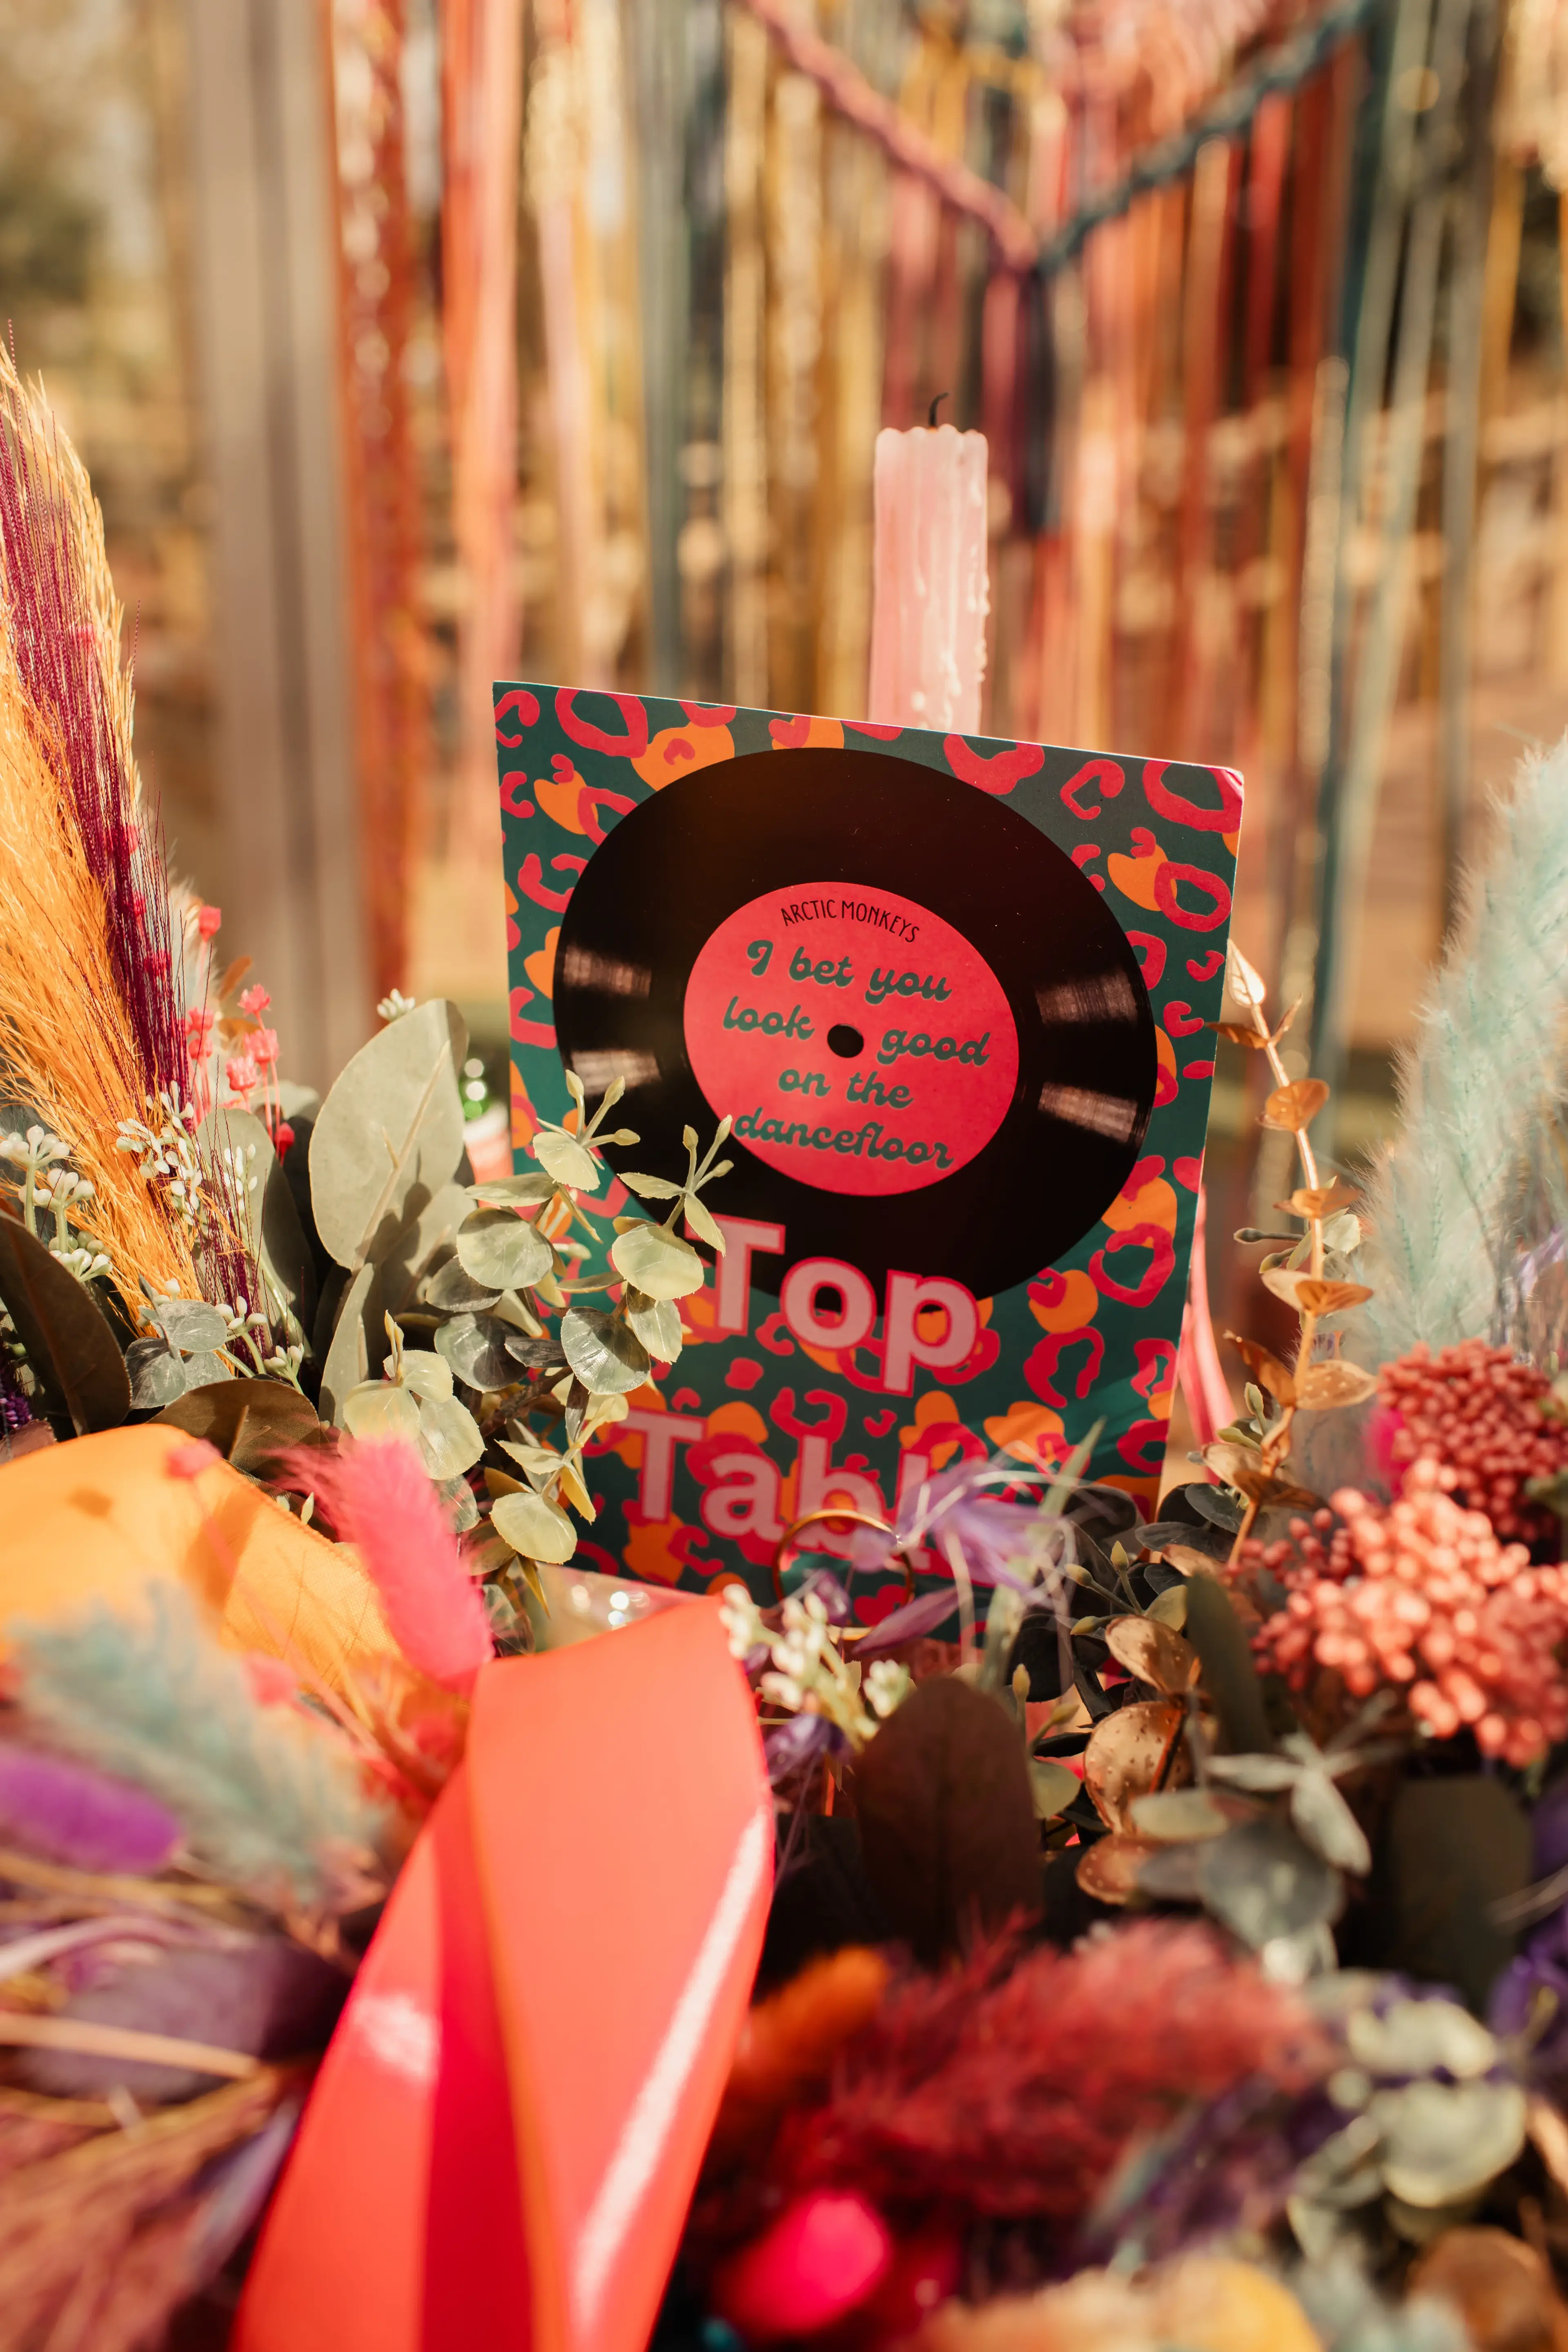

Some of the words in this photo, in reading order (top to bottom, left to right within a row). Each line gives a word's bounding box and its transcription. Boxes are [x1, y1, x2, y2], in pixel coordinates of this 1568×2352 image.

[780, 899, 837, 927] ARCTIC
[841, 900, 920, 943] MONKEYS
[788, 946, 855, 988] bet
[864, 967, 953, 1005] you
[722, 996, 815, 1040] look
[876, 1029, 991, 1067] good
[778, 1068, 832, 1097] on
[846, 1070, 914, 1110] the
[734, 1106, 954, 1170] dancefloor
[684, 1211, 979, 1397] Top
